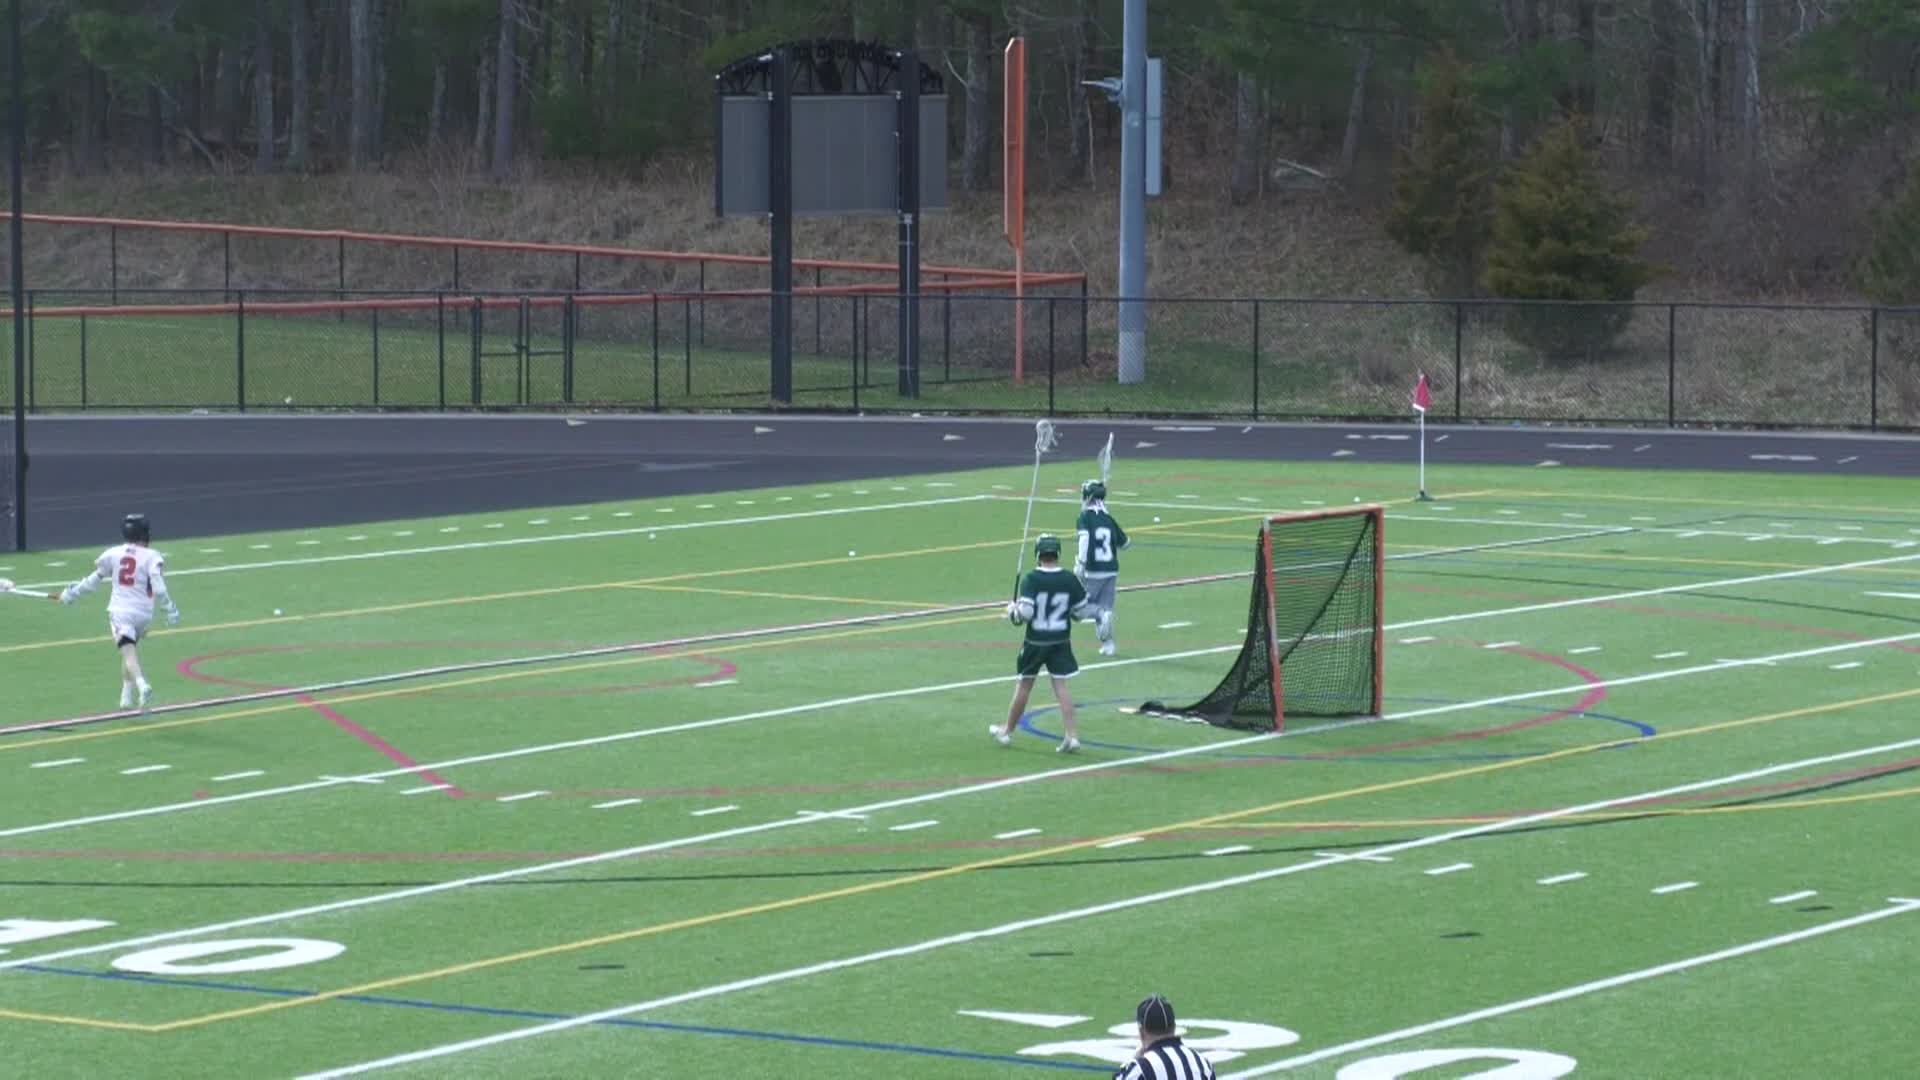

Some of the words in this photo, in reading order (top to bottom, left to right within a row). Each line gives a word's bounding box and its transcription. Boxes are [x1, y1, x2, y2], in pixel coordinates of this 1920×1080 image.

[1094, 527, 1113, 562] 3
[118, 556, 137, 586] 2
[1031, 592, 1070, 631] 12
